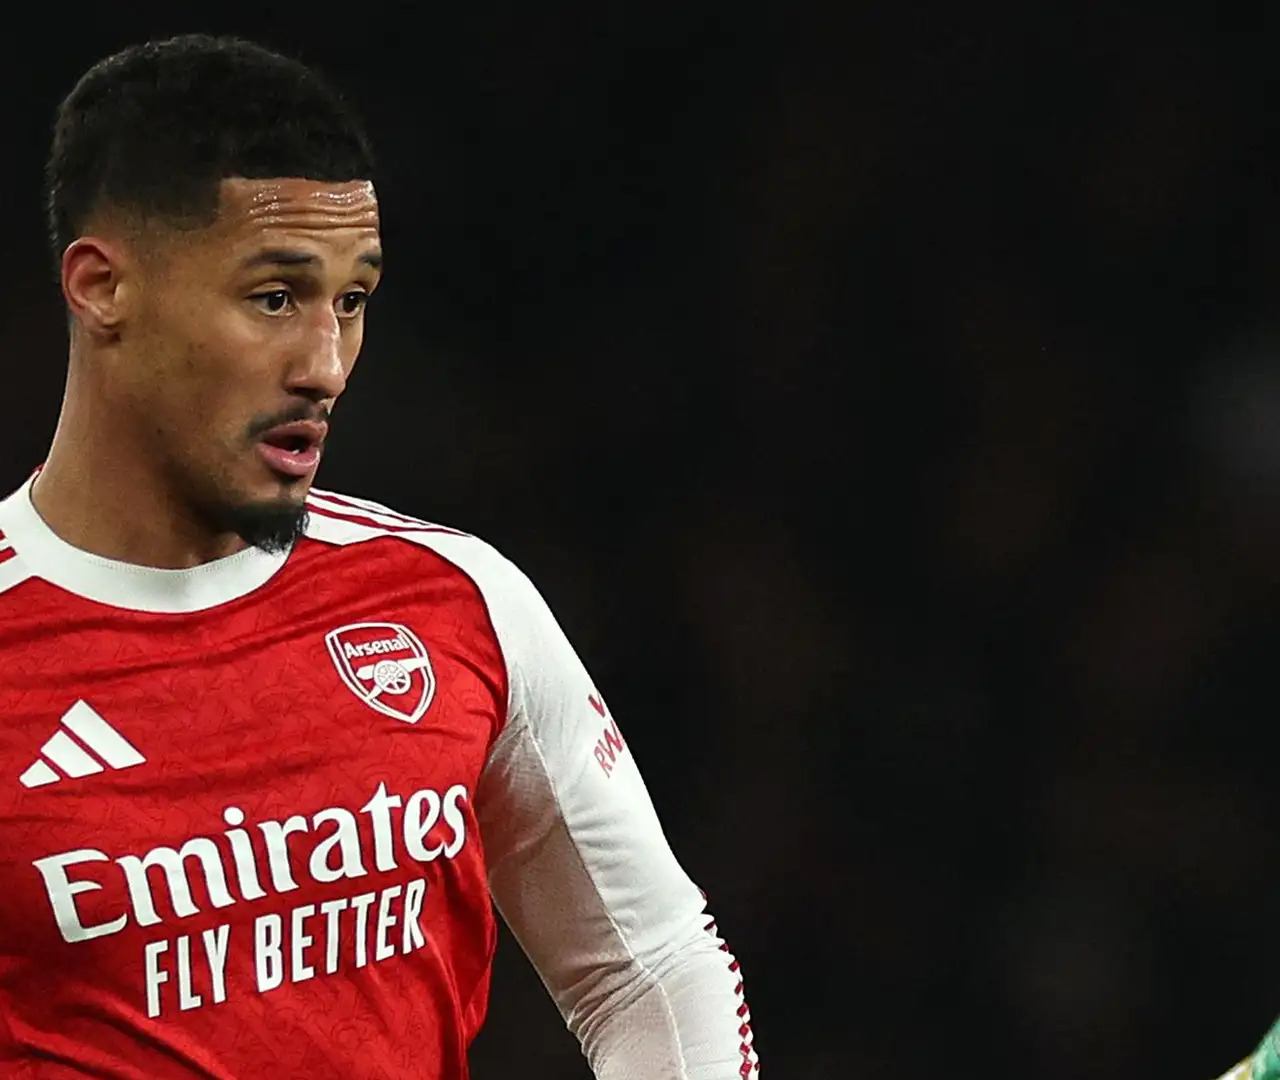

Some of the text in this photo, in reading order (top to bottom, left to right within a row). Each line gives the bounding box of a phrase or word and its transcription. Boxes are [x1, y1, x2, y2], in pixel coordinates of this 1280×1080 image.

[343, 632, 412, 660] Arsenal
[32, 781, 468, 943] Emirates
[144, 878, 427, 1018] FLY BETTER
